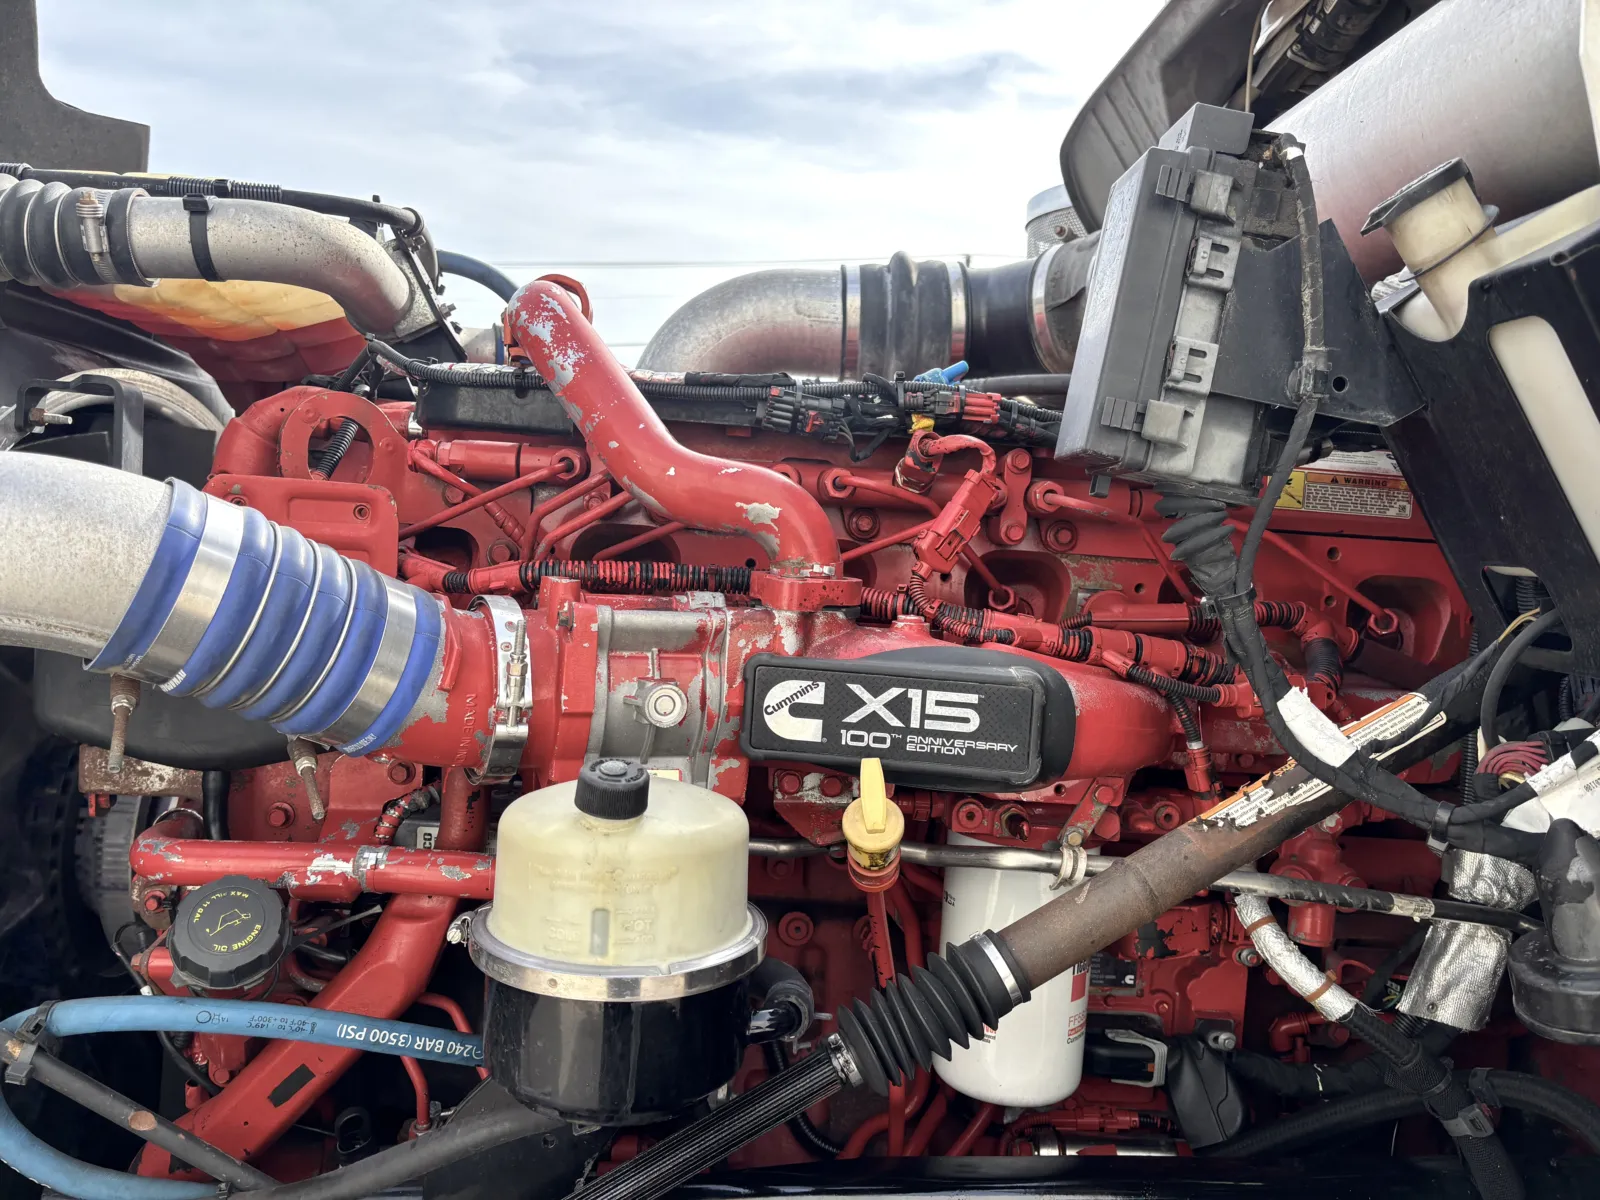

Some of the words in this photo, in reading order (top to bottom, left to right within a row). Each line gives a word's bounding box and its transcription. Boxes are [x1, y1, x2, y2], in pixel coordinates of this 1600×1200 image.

[1344, 476, 1388, 486] WARNING
[764, 680, 820, 716] Cummins
[464, 693, 477, 734] MADE
[842, 684, 980, 733] X15
[1405, 708, 1422, 719] function
[460, 736, 472, 747] IN
[906, 735, 1018, 752] ANNIVERSARY
[906, 743, 966, 756] EDITION
[194, 908, 204, 924] GAL
[232, 924, 262, 950] ENGINE
[214, 944, 228, 952] OIL
[336, 1024, 367, 1041] PSI)
[370, 1029, 412, 1049] (3500
[414, 1035, 446, 1052] BAR
[447, 1041, 474, 1056] 240
